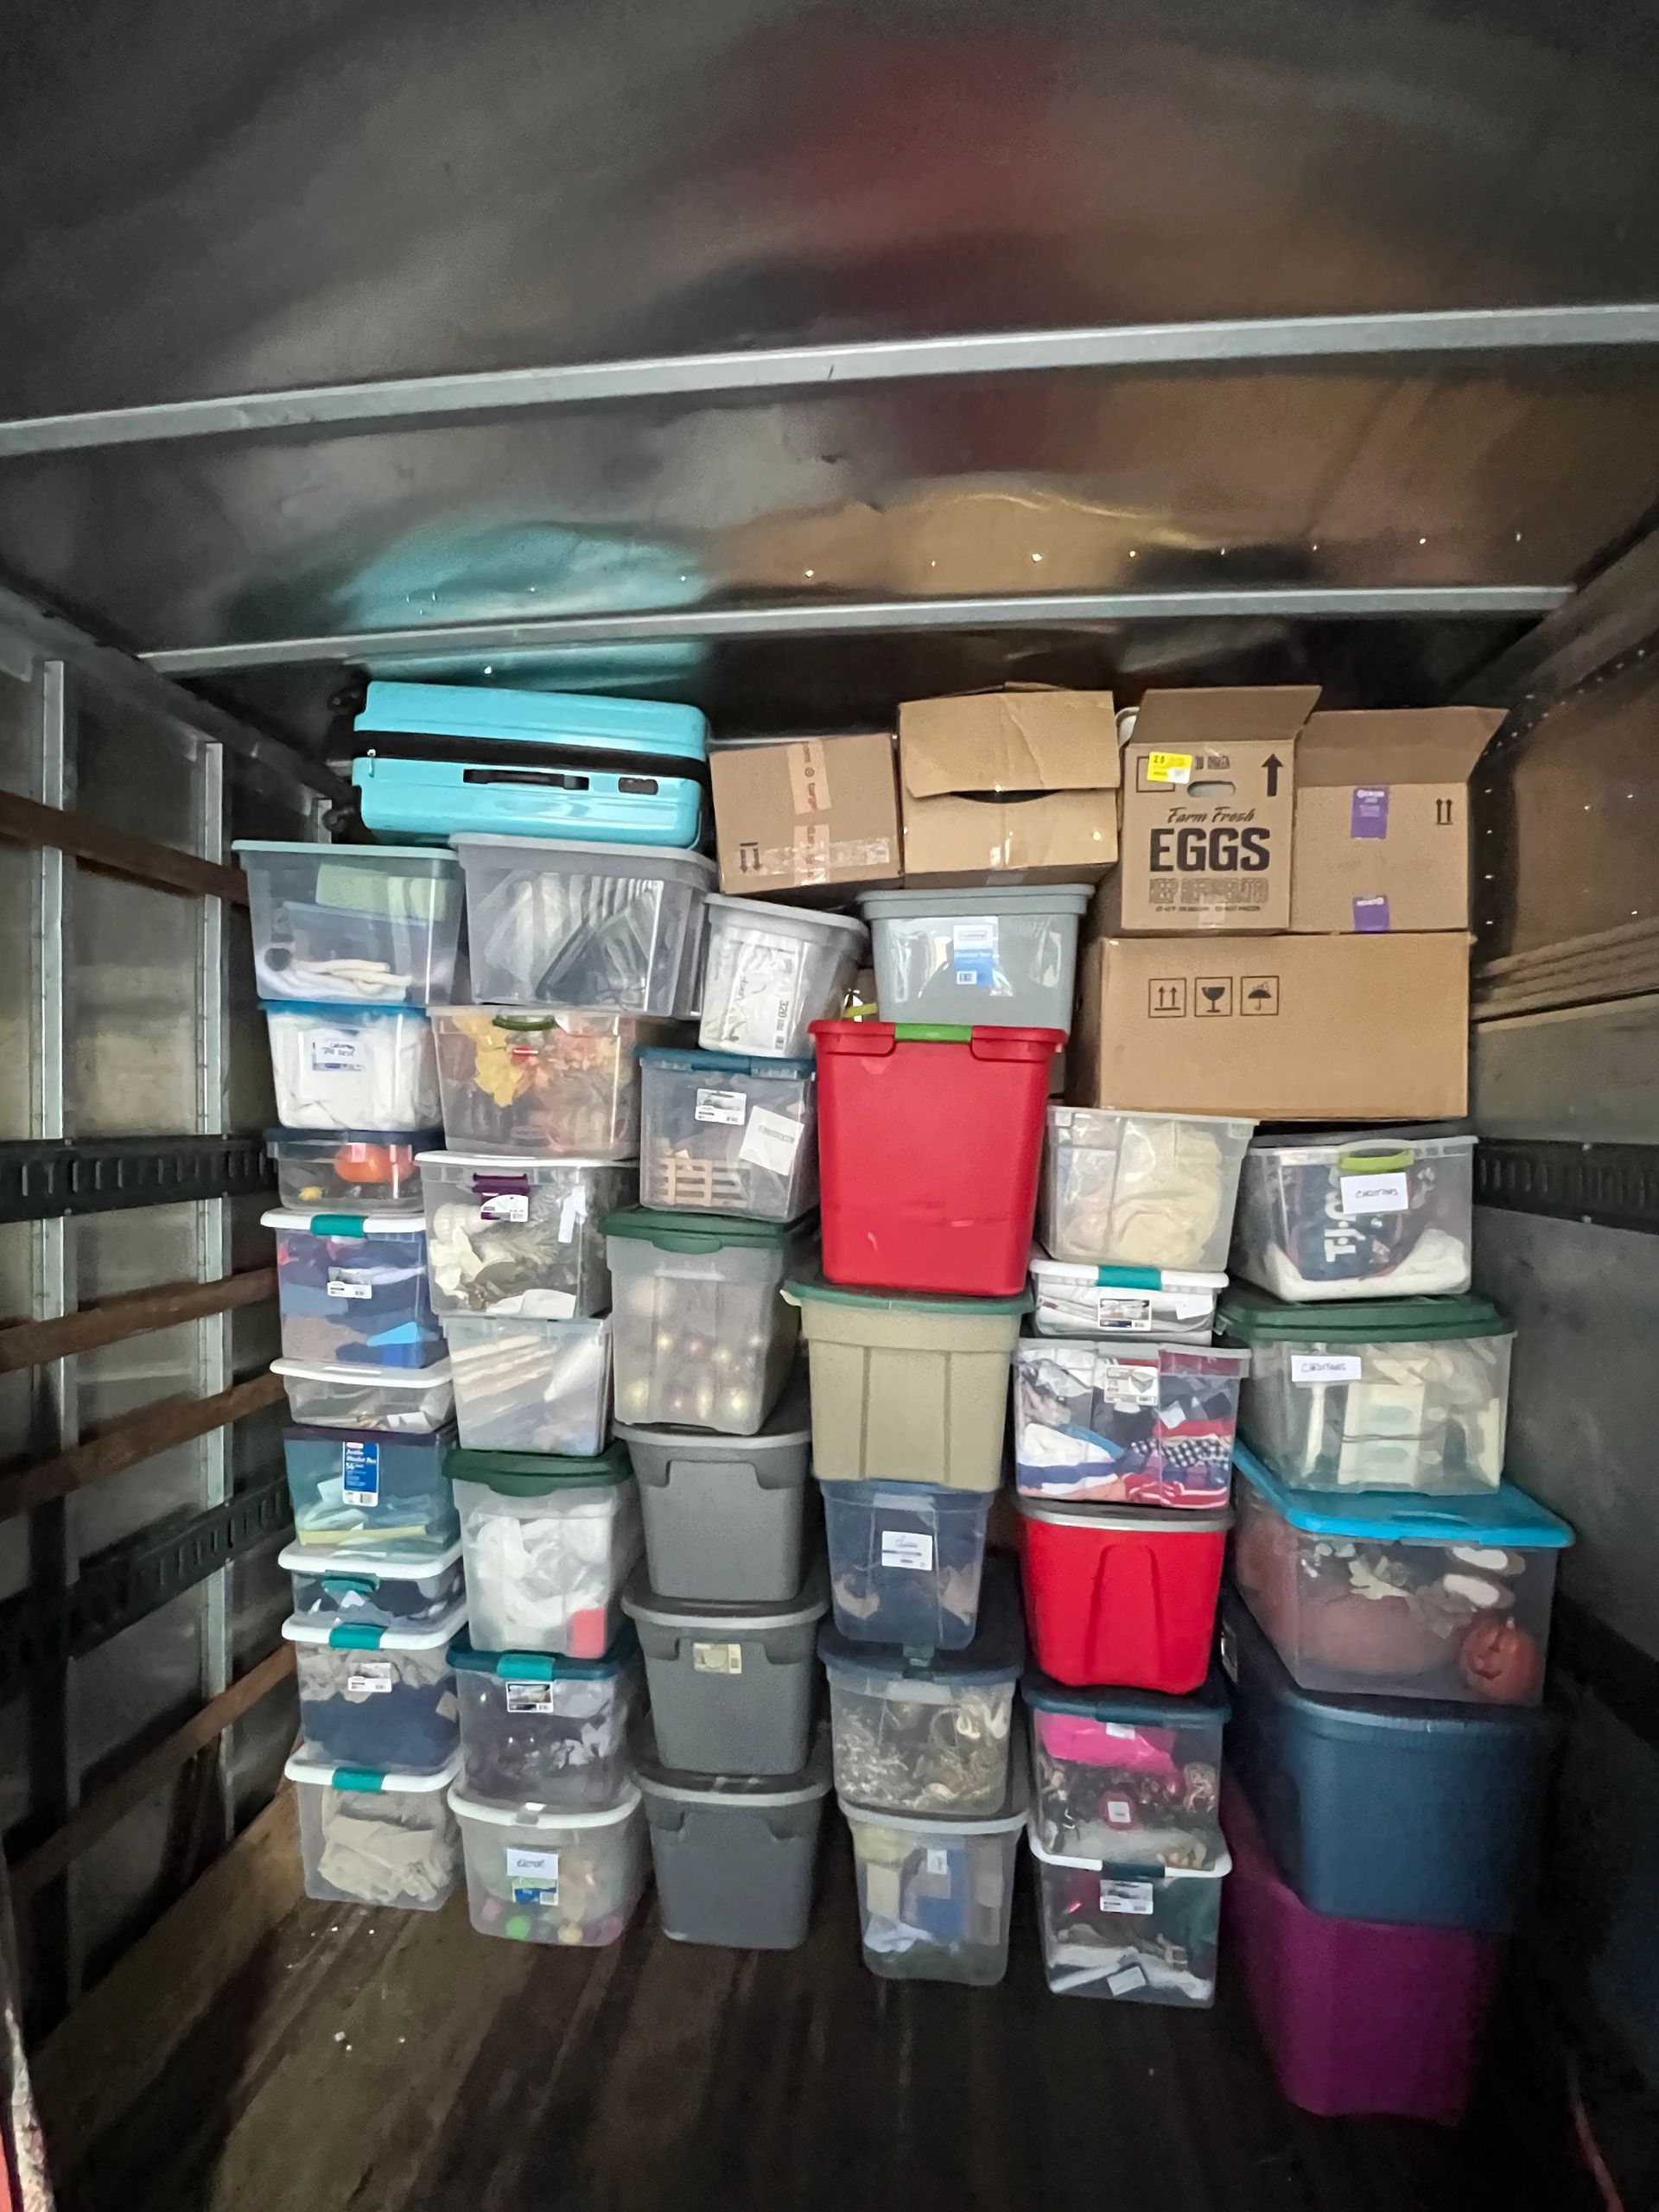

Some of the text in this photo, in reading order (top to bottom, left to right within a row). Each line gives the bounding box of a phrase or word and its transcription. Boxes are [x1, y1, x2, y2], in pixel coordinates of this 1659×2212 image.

[1167, 805, 1256, 823] Farm Fresh
[1149, 827, 1271, 873] EGGS
[777, 1000, 789, 1019] 320
